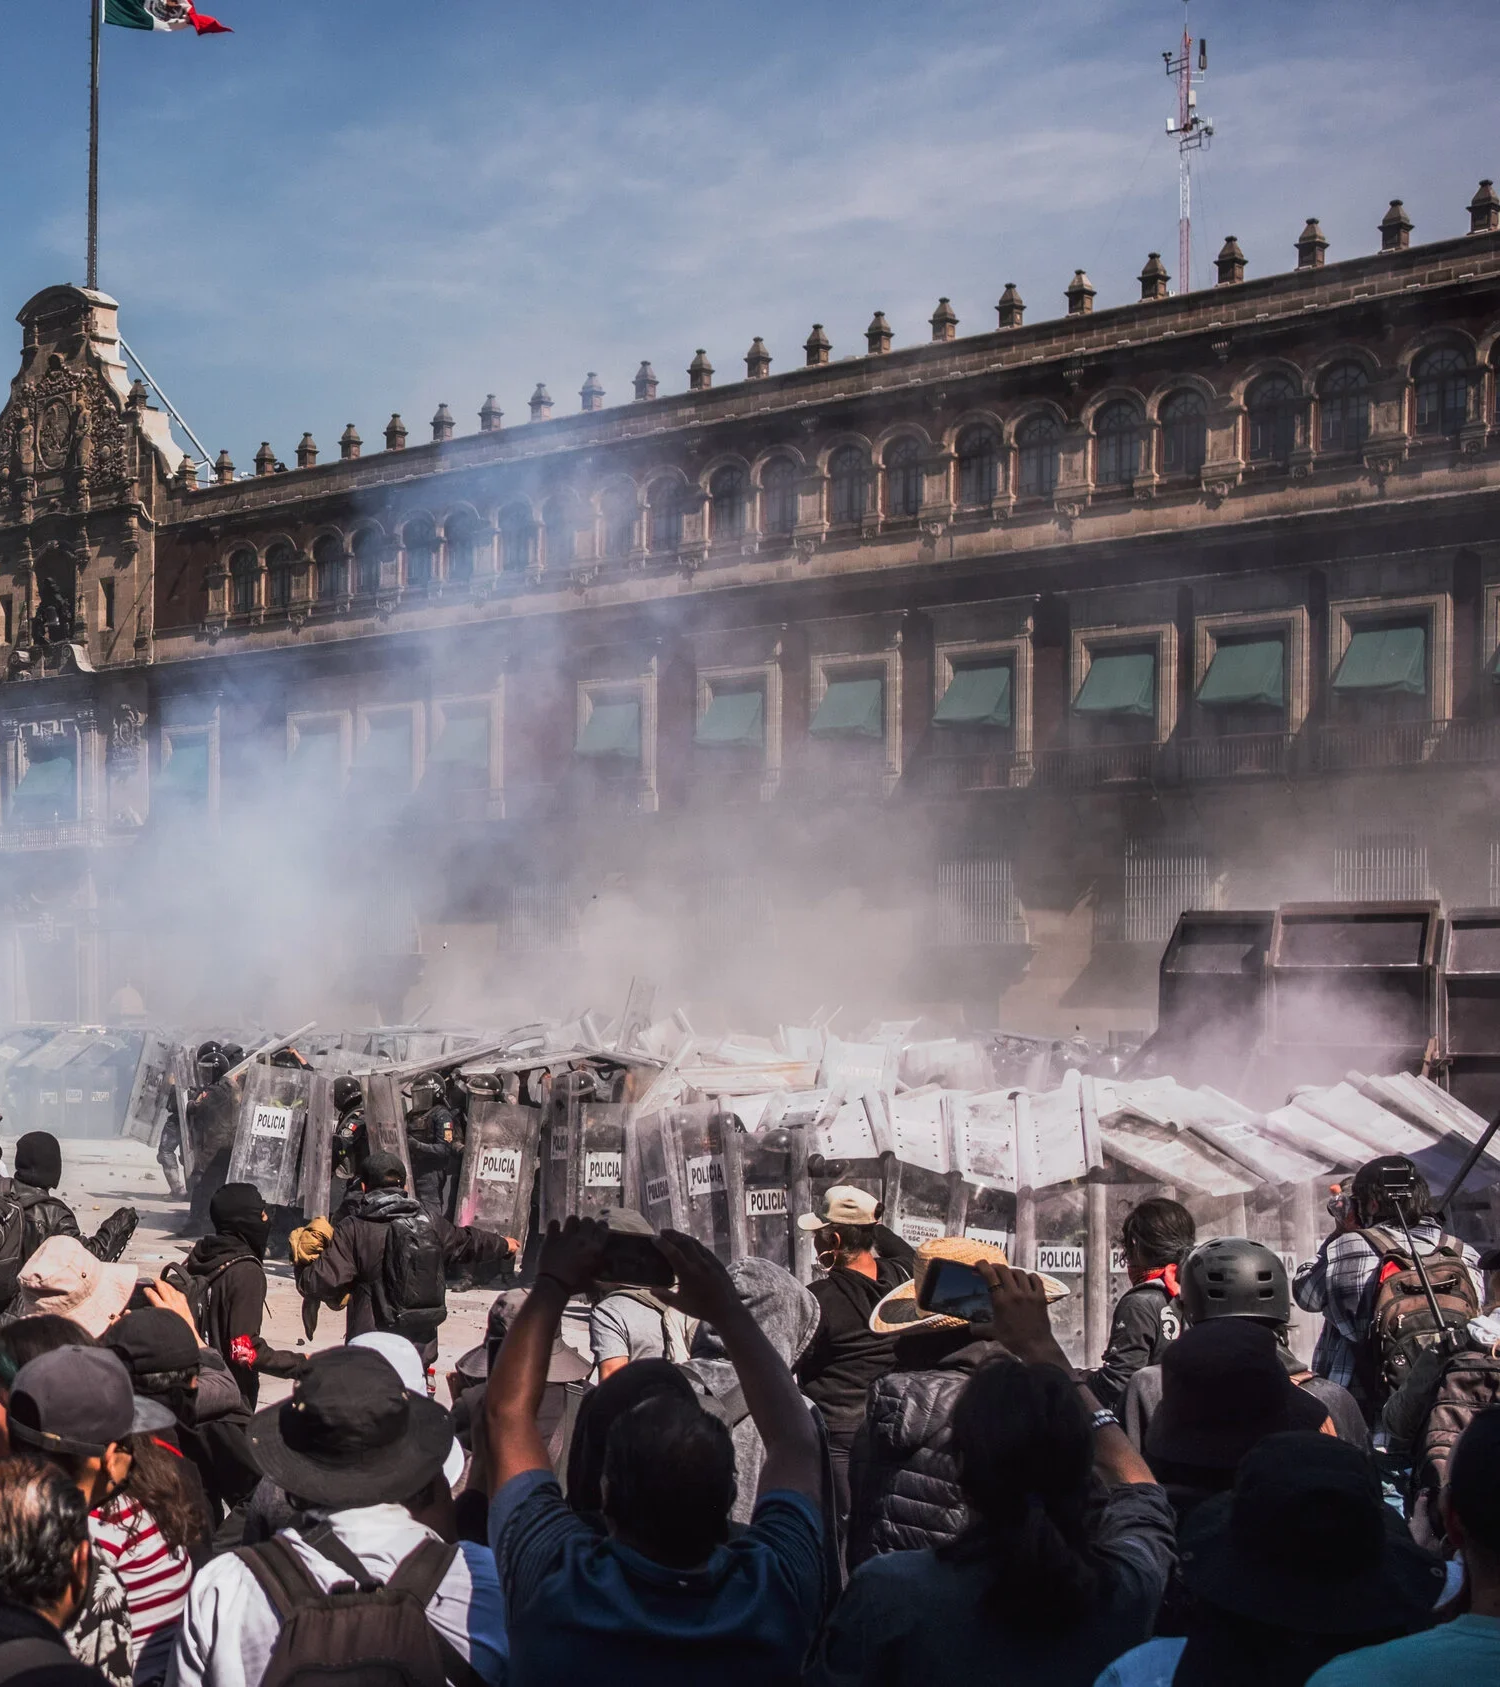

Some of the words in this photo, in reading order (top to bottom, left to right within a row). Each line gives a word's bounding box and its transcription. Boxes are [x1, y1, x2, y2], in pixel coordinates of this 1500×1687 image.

[257, 1113, 286, 1130] POLICIA
[482, 1156, 515, 1174] POLICIA
[590, 1162, 620, 1178] POLICIA
[692, 1163, 723, 1185] POLICIA
[751, 1192, 787, 1212] POLICIA
[1040, 1251, 1082, 1268] POLICIA
